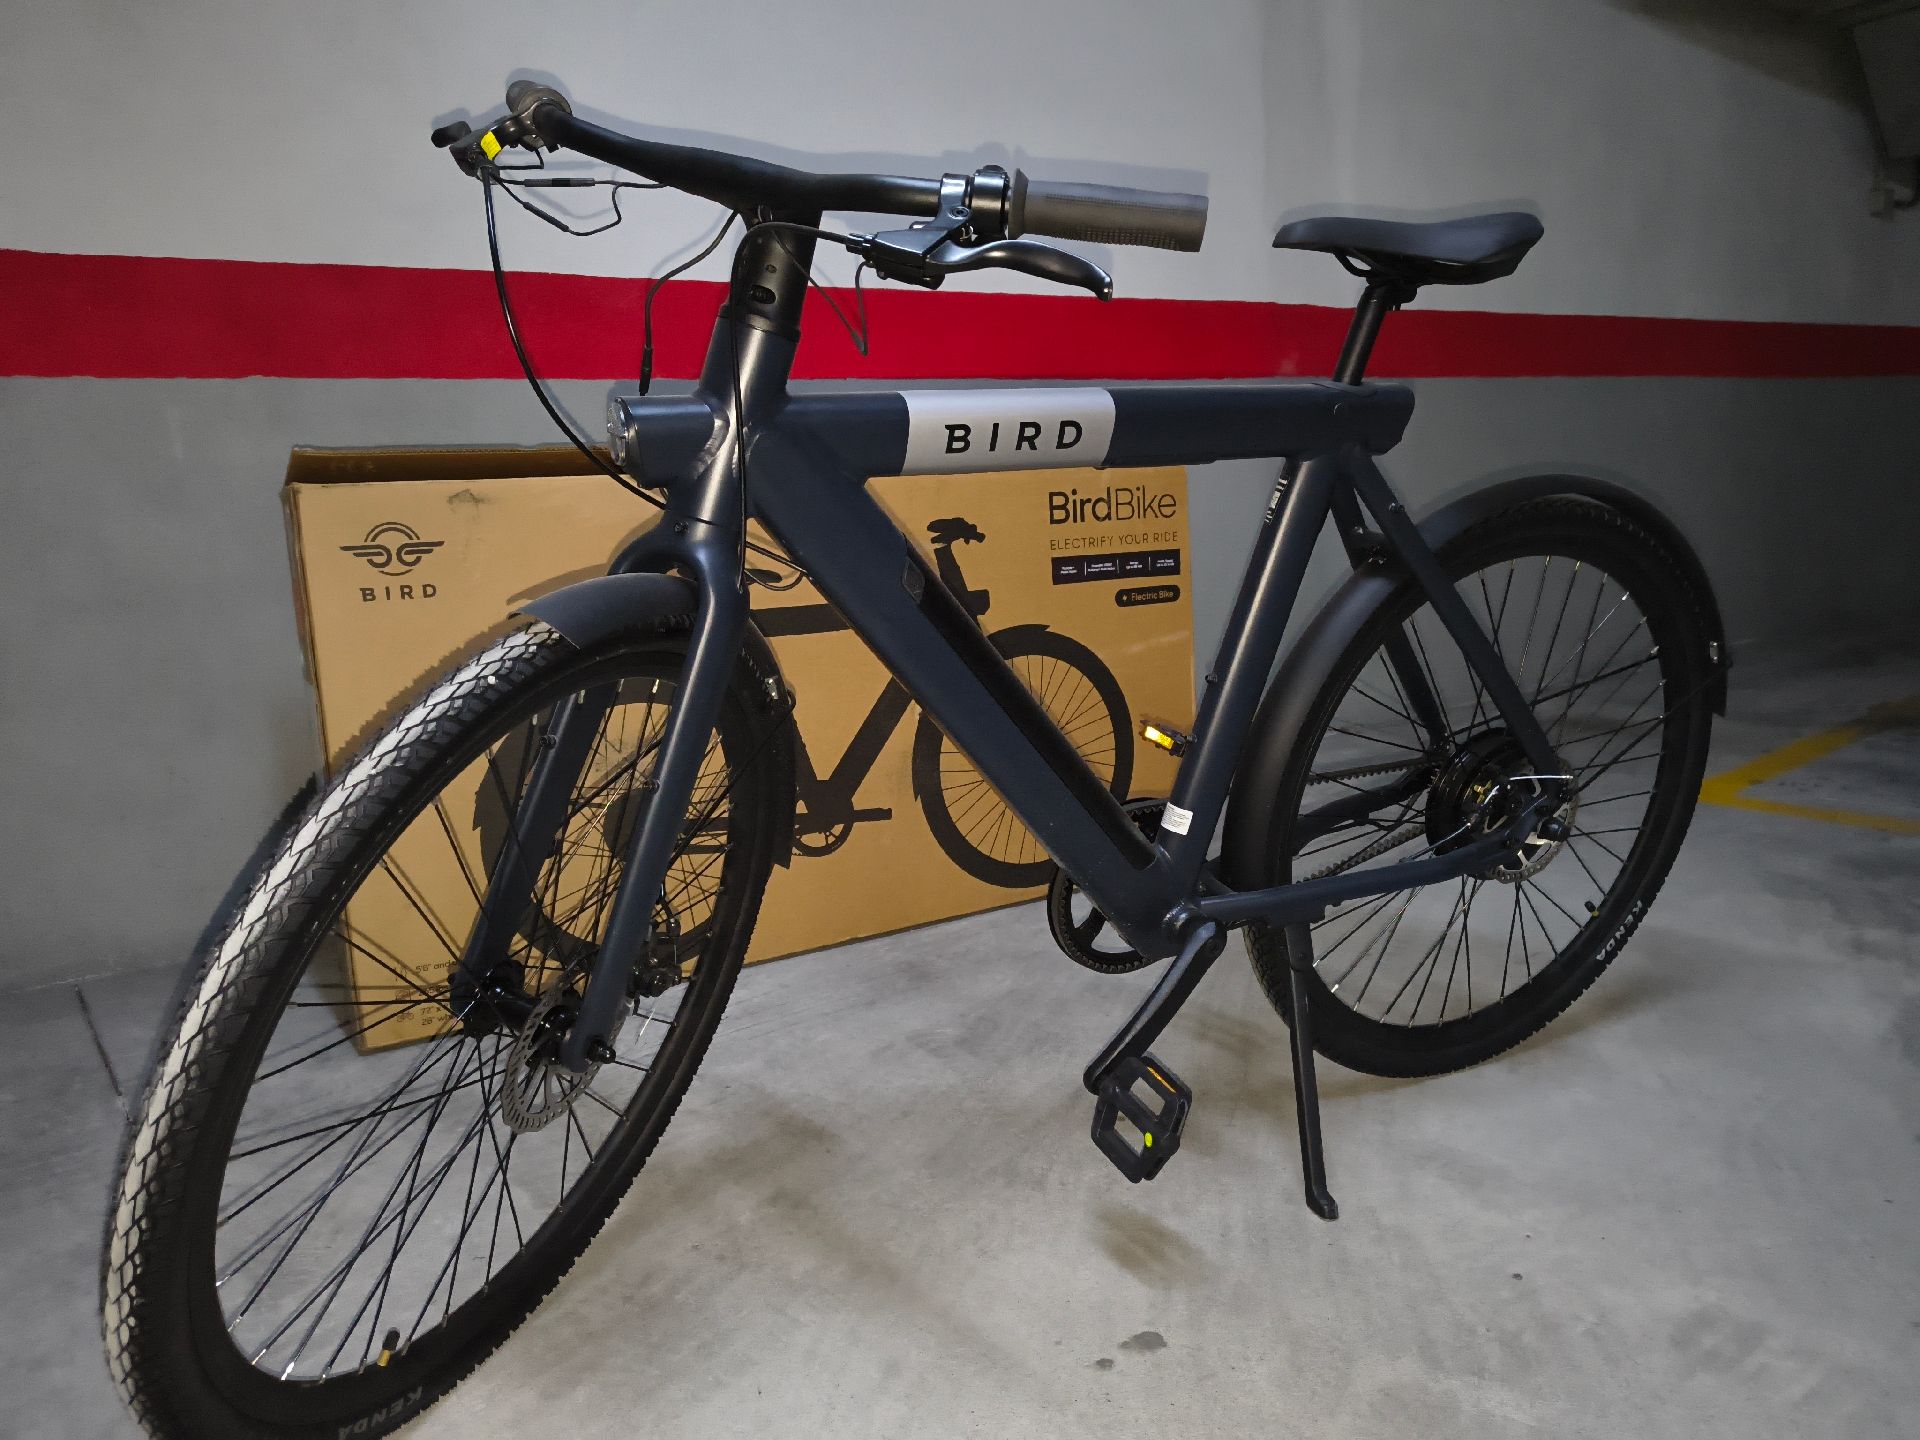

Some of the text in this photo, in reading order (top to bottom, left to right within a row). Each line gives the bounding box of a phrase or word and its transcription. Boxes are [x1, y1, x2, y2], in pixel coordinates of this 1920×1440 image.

[944, 420, 1083, 454] BIRD
[1048, 485, 1177, 525] BirdBike
[1050, 530, 1179, 551] ELECTRIFY YOUR RIDE
[359, 583, 437, 602] BIRD
[1131, 589, 1174, 601] Electric Bike
[1595, 900, 1643, 960] KENDA
[338, 1386, 423, 1440] KENDA
